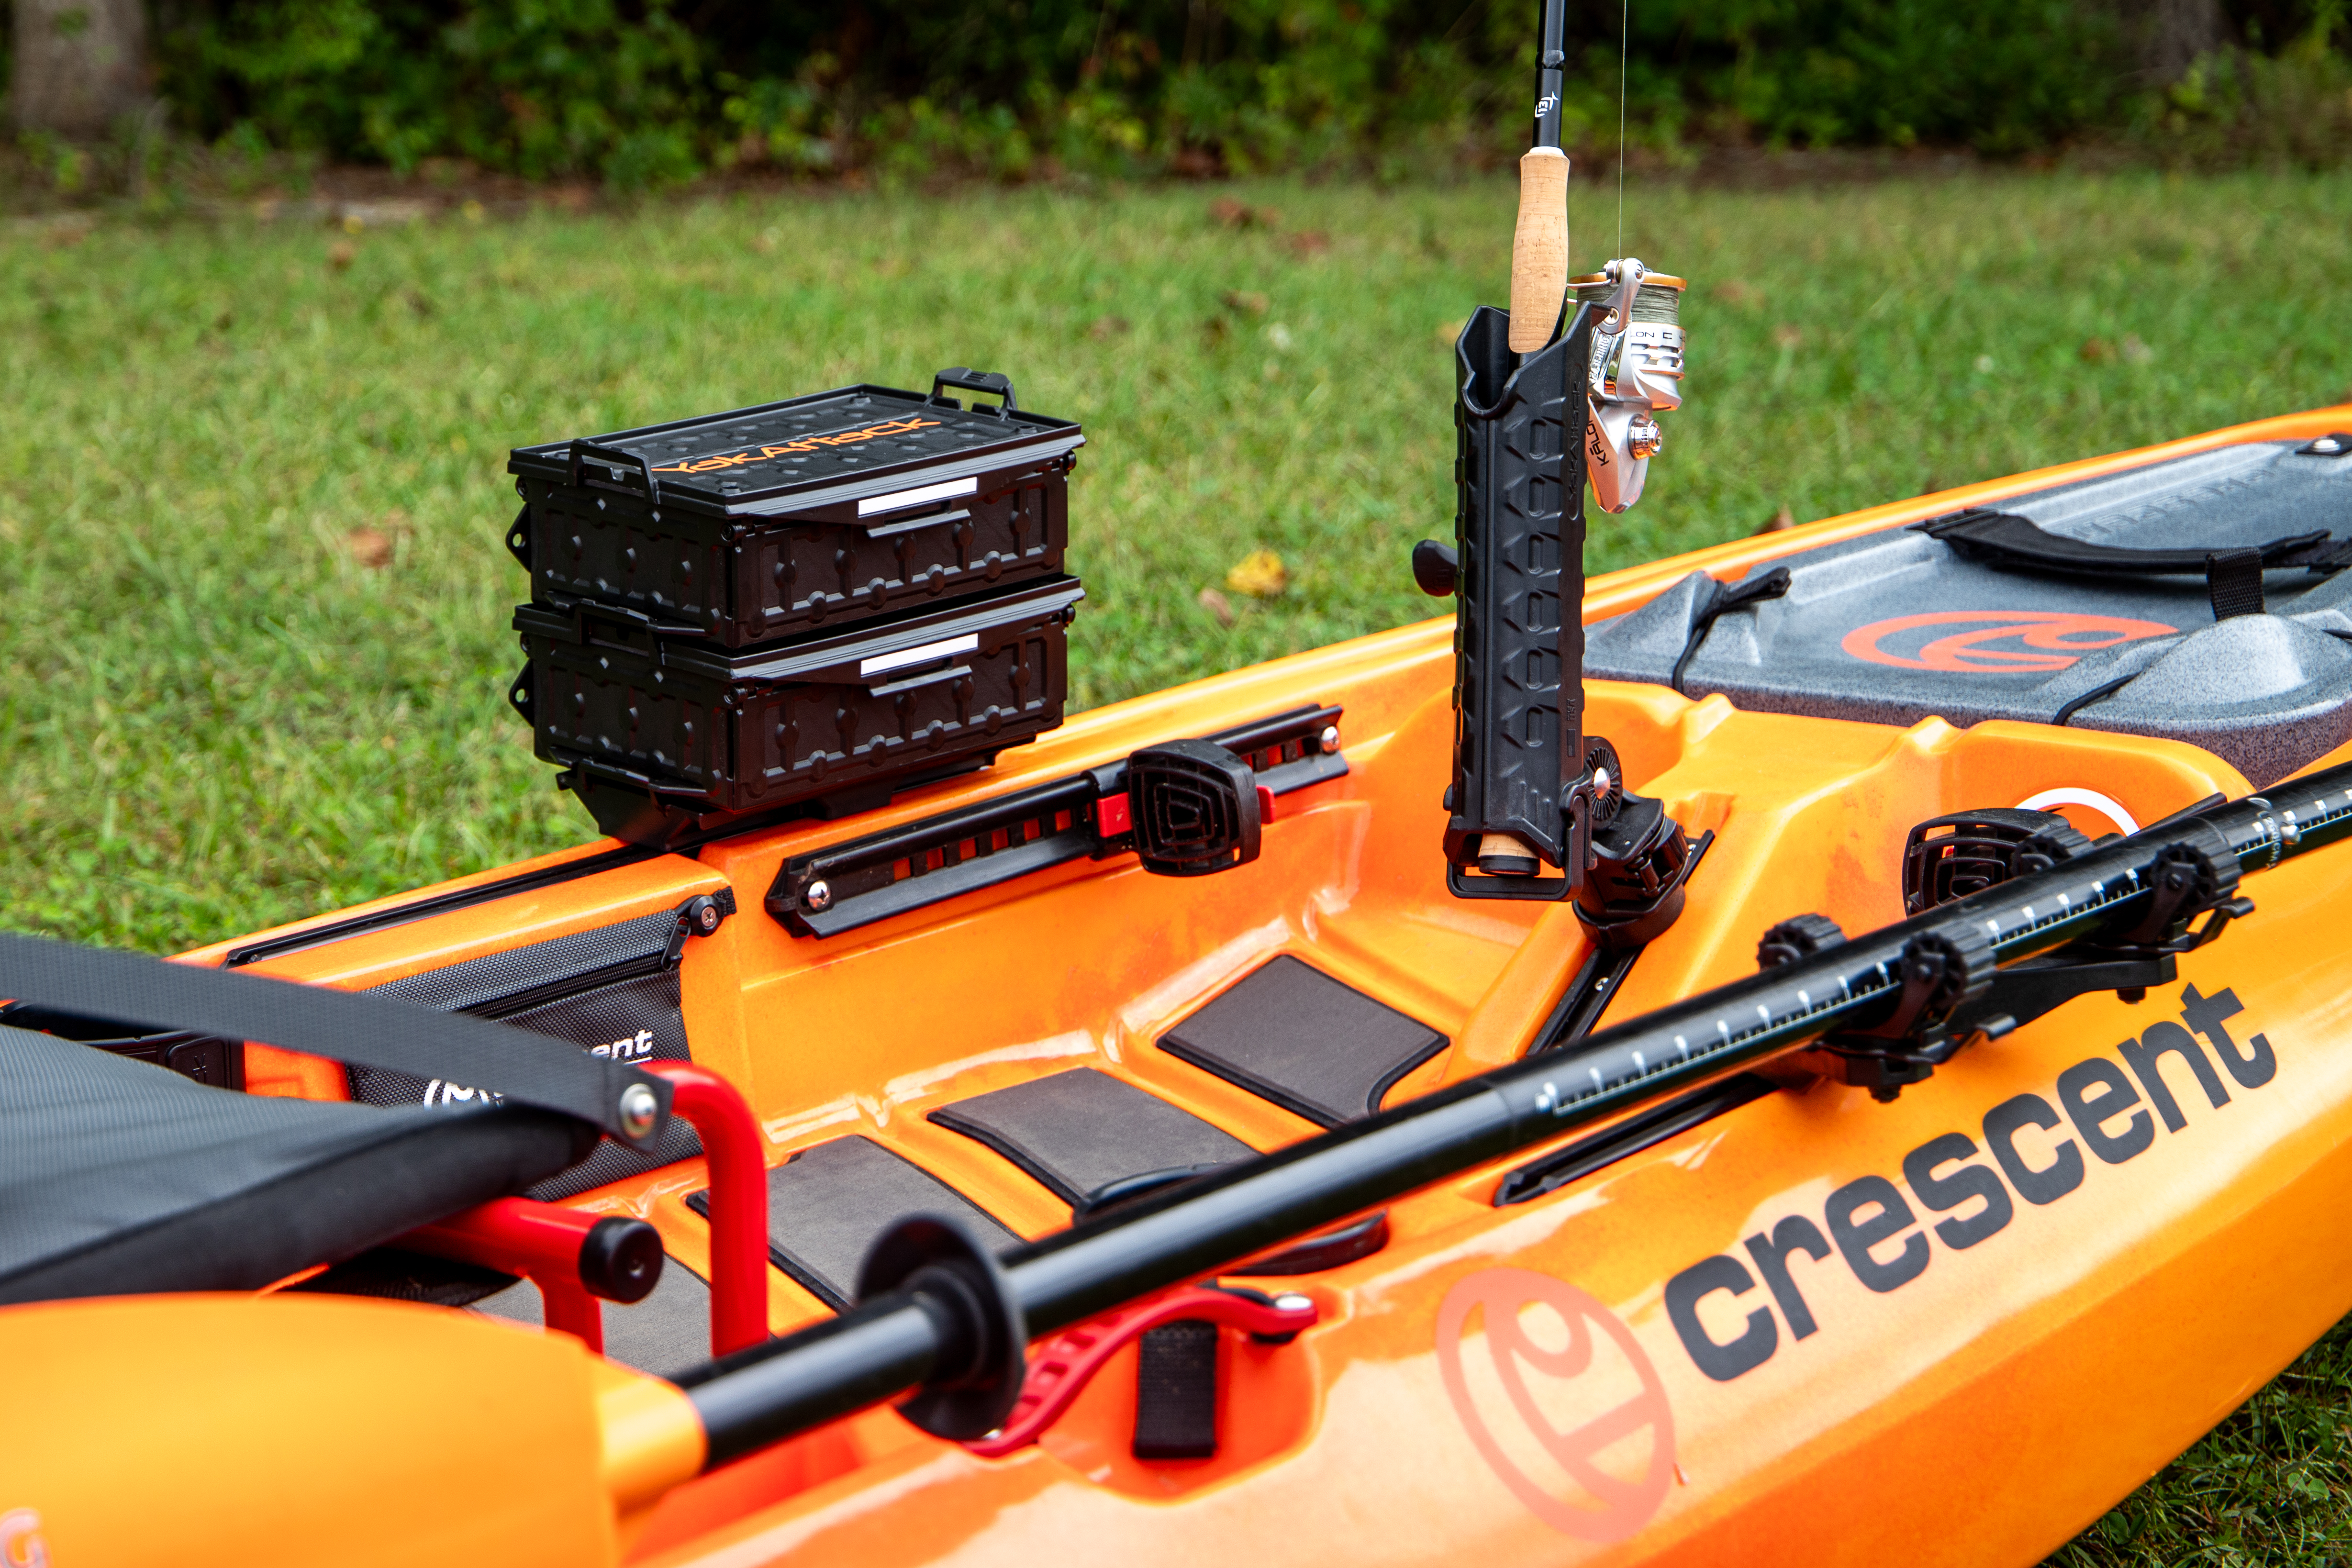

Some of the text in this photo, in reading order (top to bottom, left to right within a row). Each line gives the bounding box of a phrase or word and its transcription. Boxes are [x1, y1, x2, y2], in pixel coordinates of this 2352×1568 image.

[651, 418, 942, 473] YakAttack
[1586, 420, 1609, 467] KĀLO
[1663, 981, 2277, 1382] crescent
